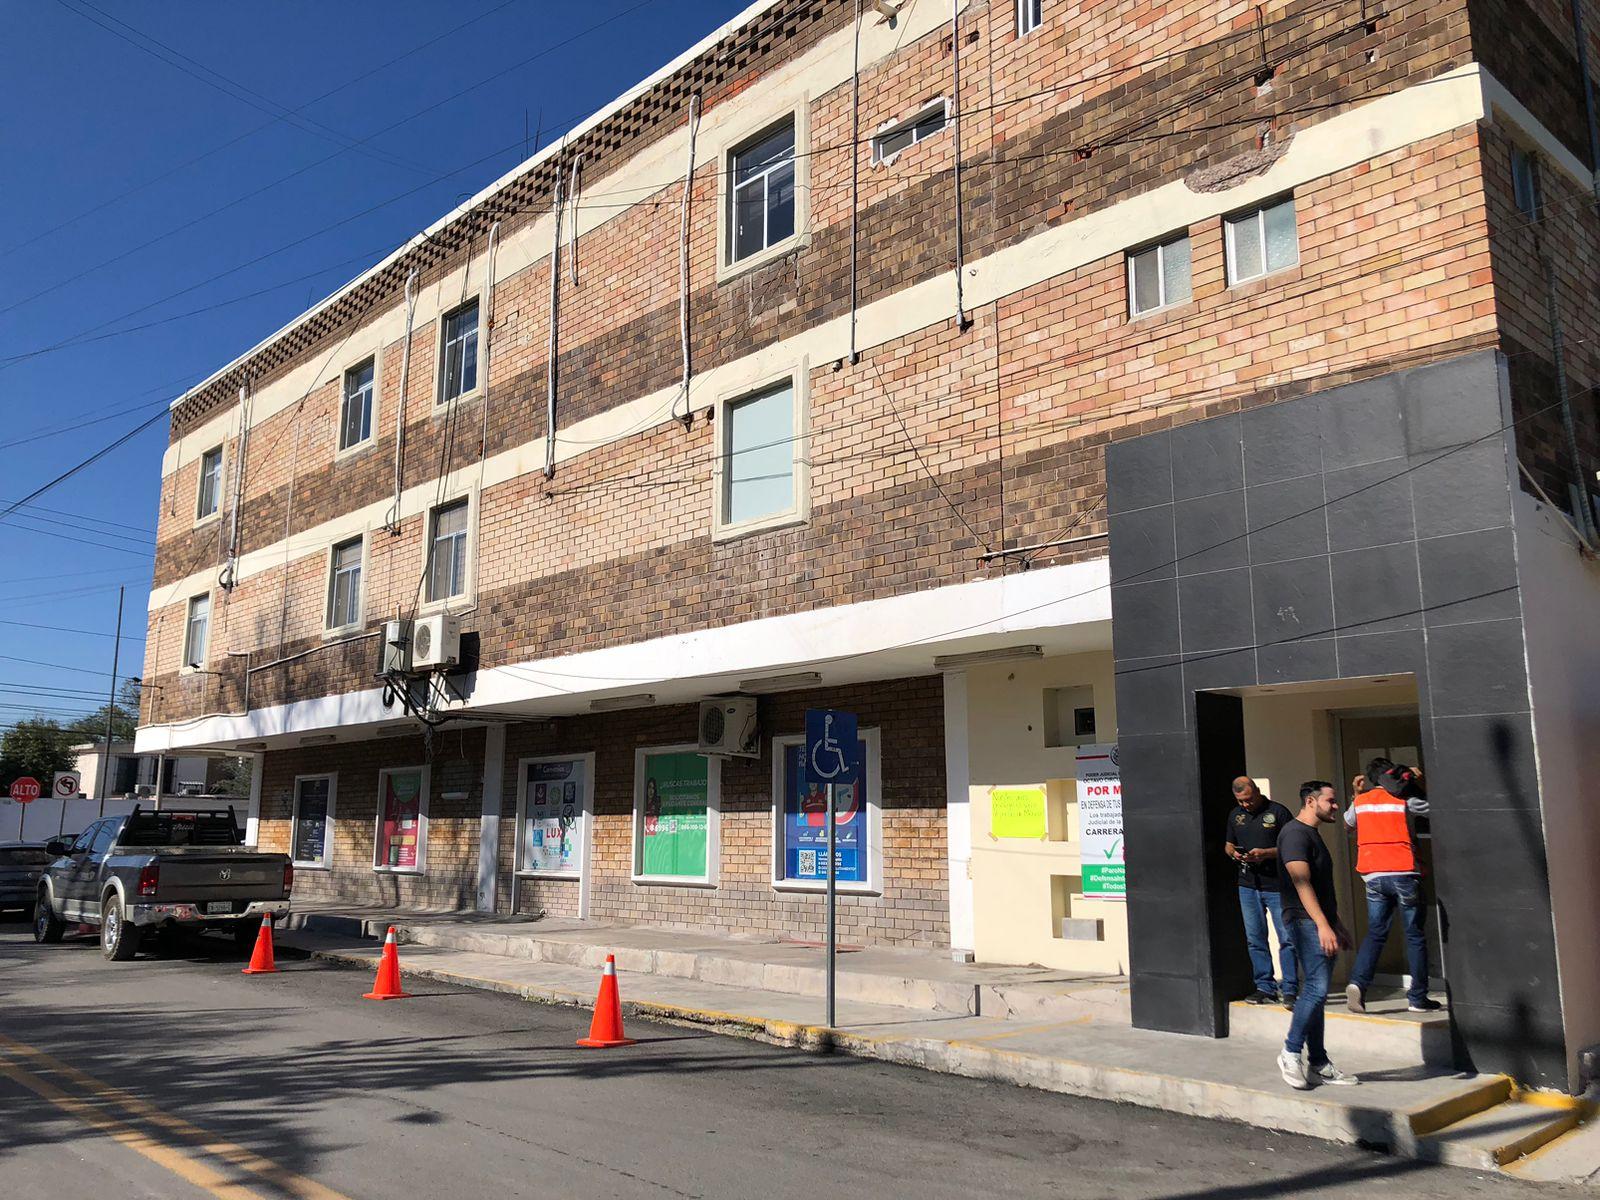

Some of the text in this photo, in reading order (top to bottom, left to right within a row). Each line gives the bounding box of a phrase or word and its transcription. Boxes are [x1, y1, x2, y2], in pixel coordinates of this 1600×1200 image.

[13, 784, 38, 796] ALTO
[1087, 786, 1109, 796] POR
[1081, 800, 1088, 810] EN
[1088, 799, 1106, 809] DEFENSA
[1106, 799, 1112, 809] DE
[1085, 828, 1124, 836] CARRERA
